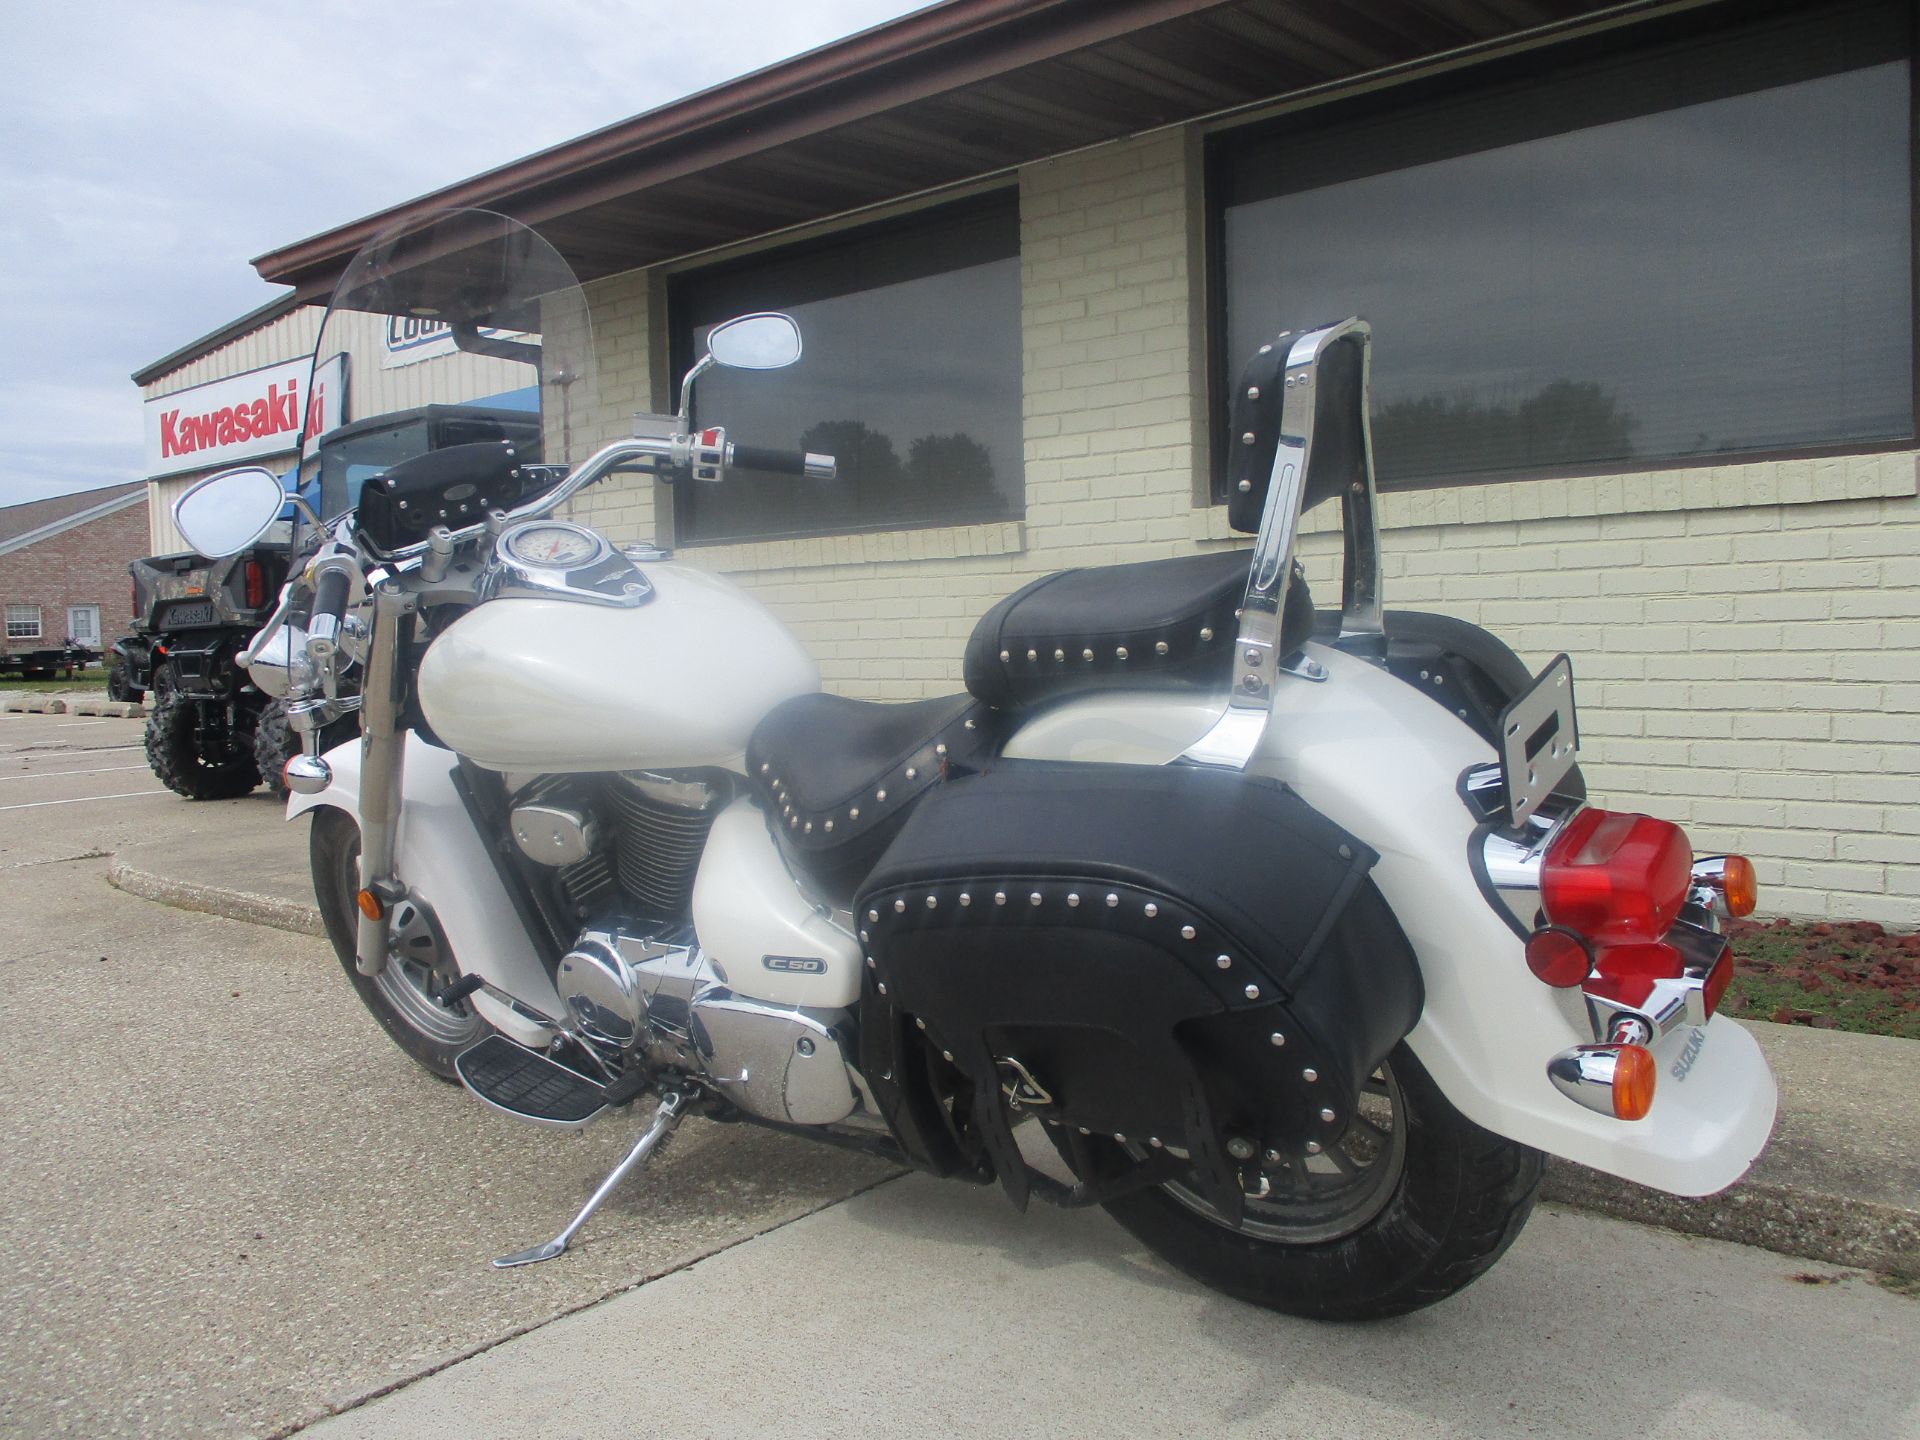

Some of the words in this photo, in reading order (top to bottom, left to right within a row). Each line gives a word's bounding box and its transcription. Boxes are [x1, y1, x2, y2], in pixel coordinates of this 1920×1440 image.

[160, 378, 298, 458] Kawasaki
[167, 604, 214, 625] Kawasaki
[768, 959, 818, 971] C50
[1671, 1028, 1705, 1082] SUZUKI
